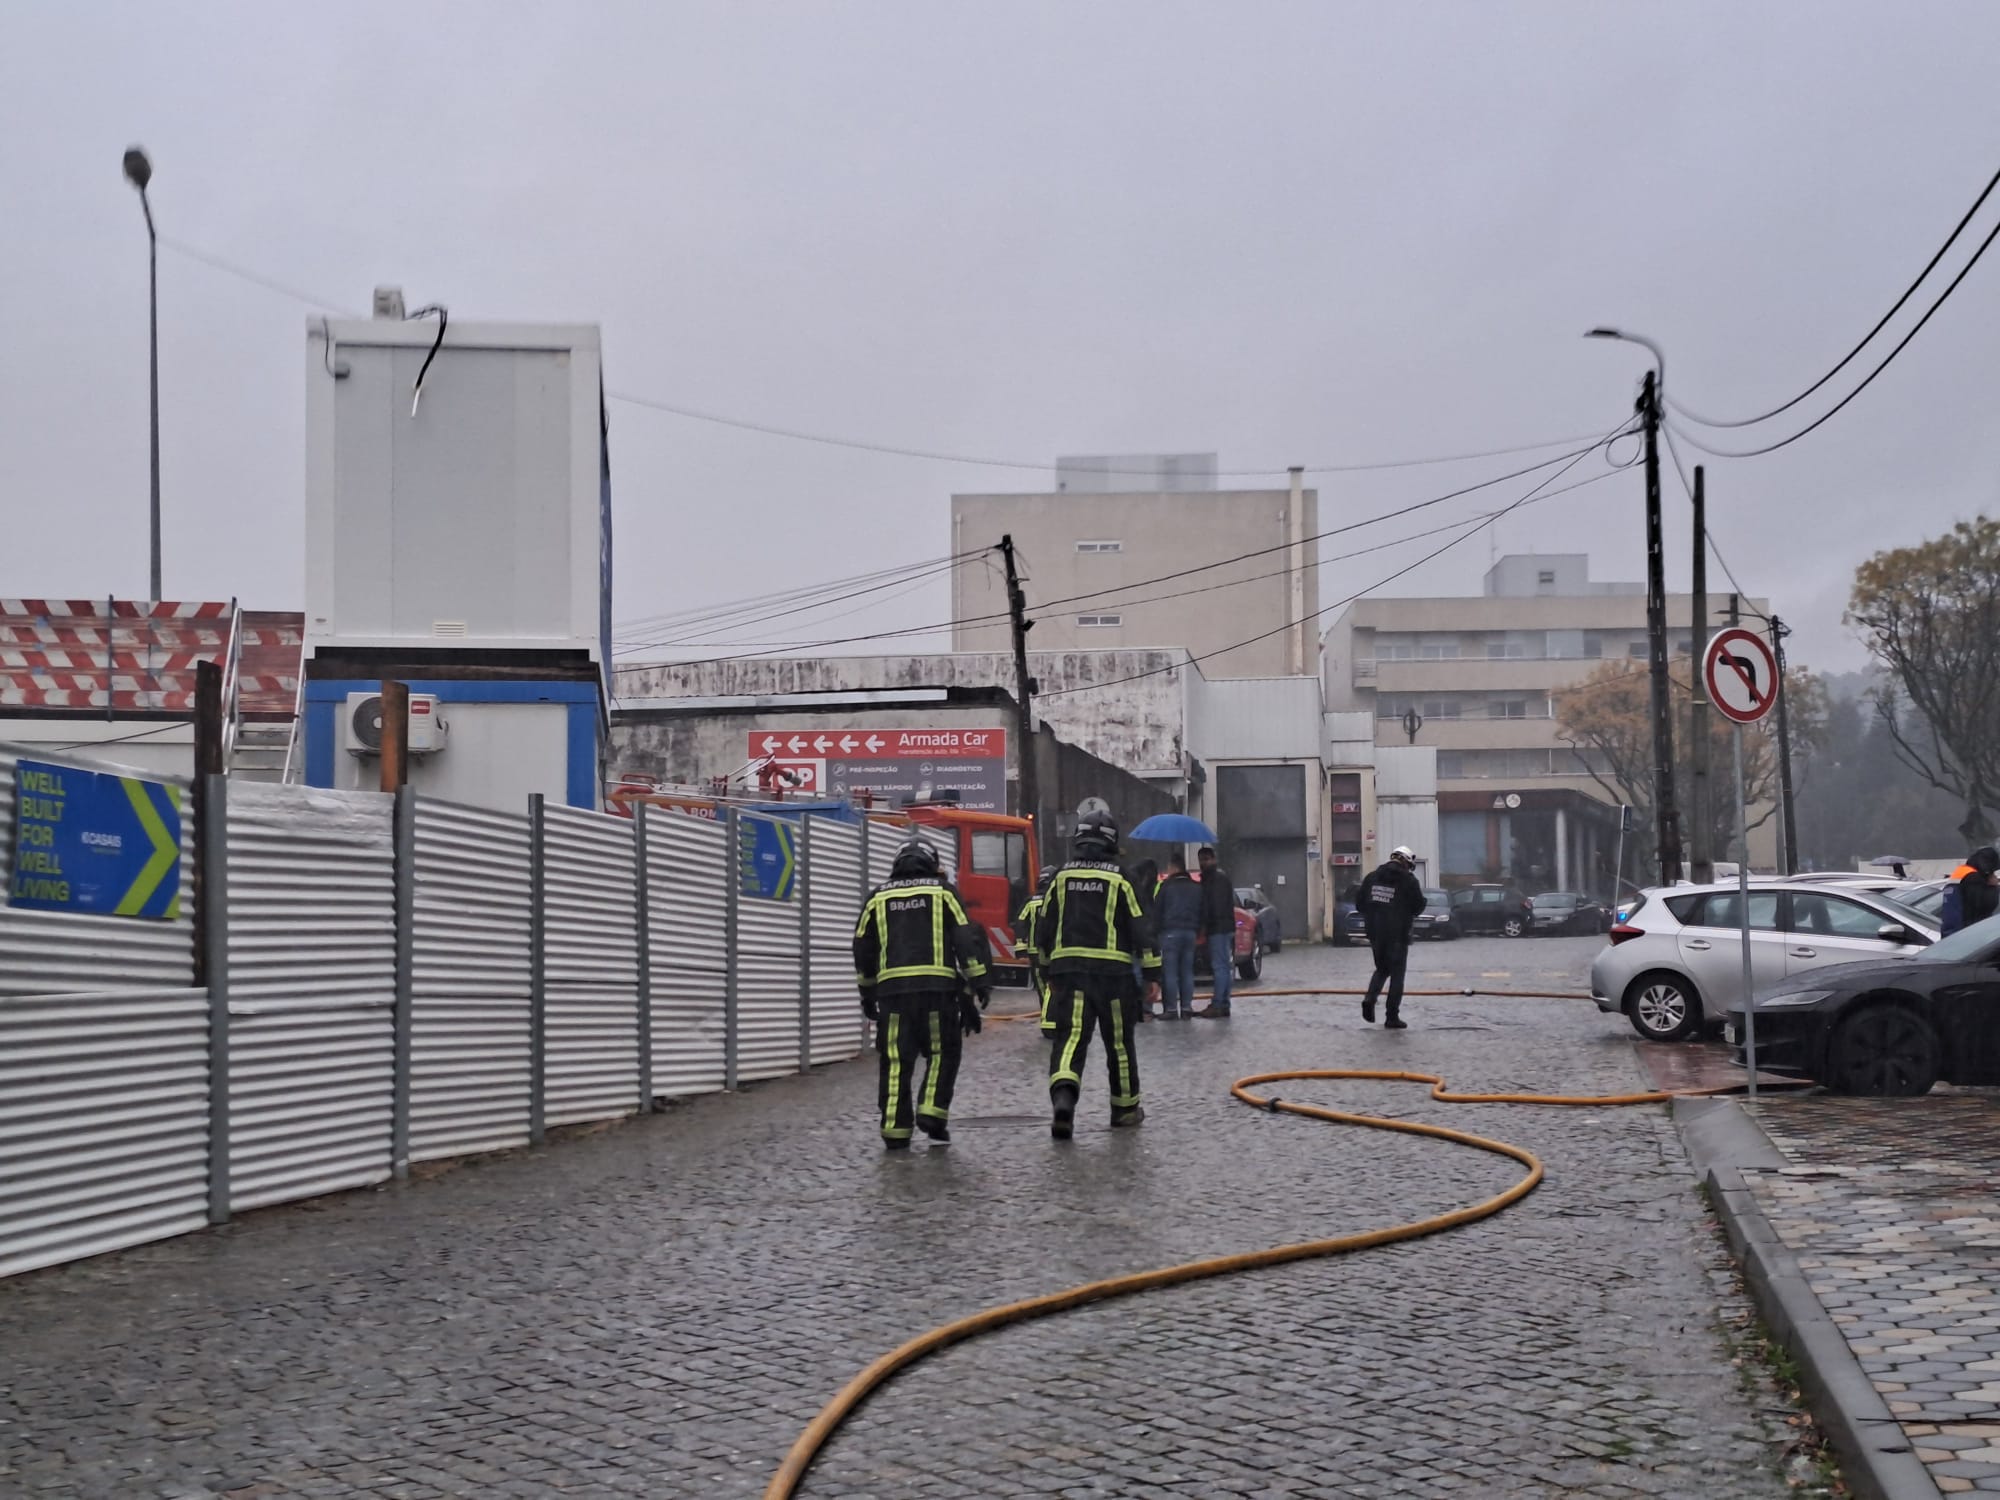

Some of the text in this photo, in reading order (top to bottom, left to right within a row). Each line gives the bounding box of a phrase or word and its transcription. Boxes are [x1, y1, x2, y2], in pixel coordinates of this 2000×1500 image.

[899, 732, 989, 746] Armada Car
[20, 770, 66, 796] WELL
[21, 797, 64, 821] BUILT
[20, 823, 54, 847] FOR
[19, 851, 62, 875] WELL
[1063, 861, 1120, 873] SAPADORES
[12, 877, 70, 902] LIVING
[880, 878, 940, 891] SAPADORES
[1068, 881, 1104, 893] BRAGA
[889, 898, 927, 911] BRAGA
